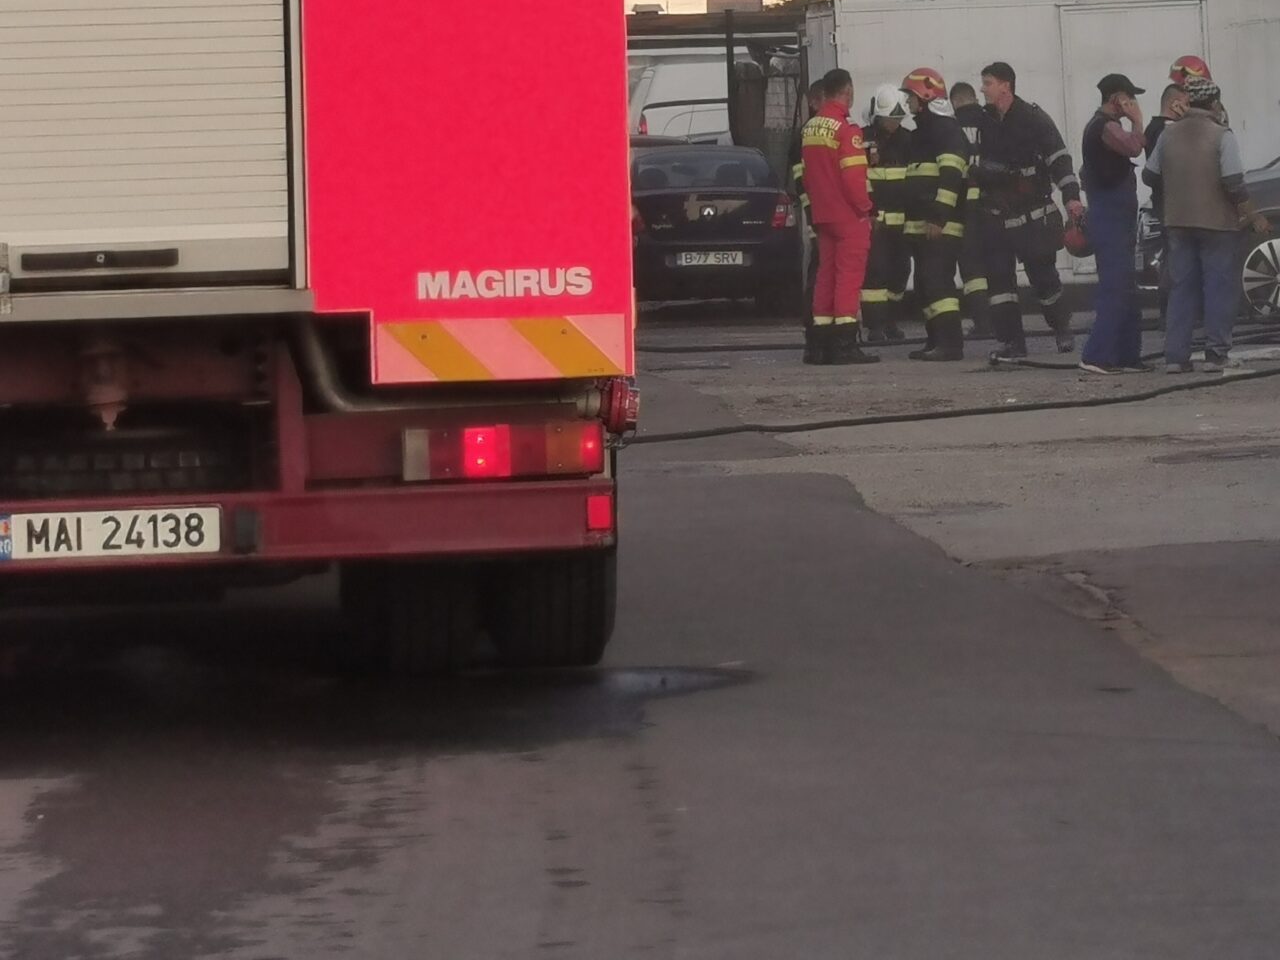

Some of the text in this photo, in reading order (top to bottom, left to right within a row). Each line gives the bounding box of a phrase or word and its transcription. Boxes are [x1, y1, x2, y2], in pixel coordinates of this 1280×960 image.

[714, 252, 738, 264] SRV
[418, 266, 593, 300] MAGIRUS
[26, 513, 205, 552] MAI 24138
